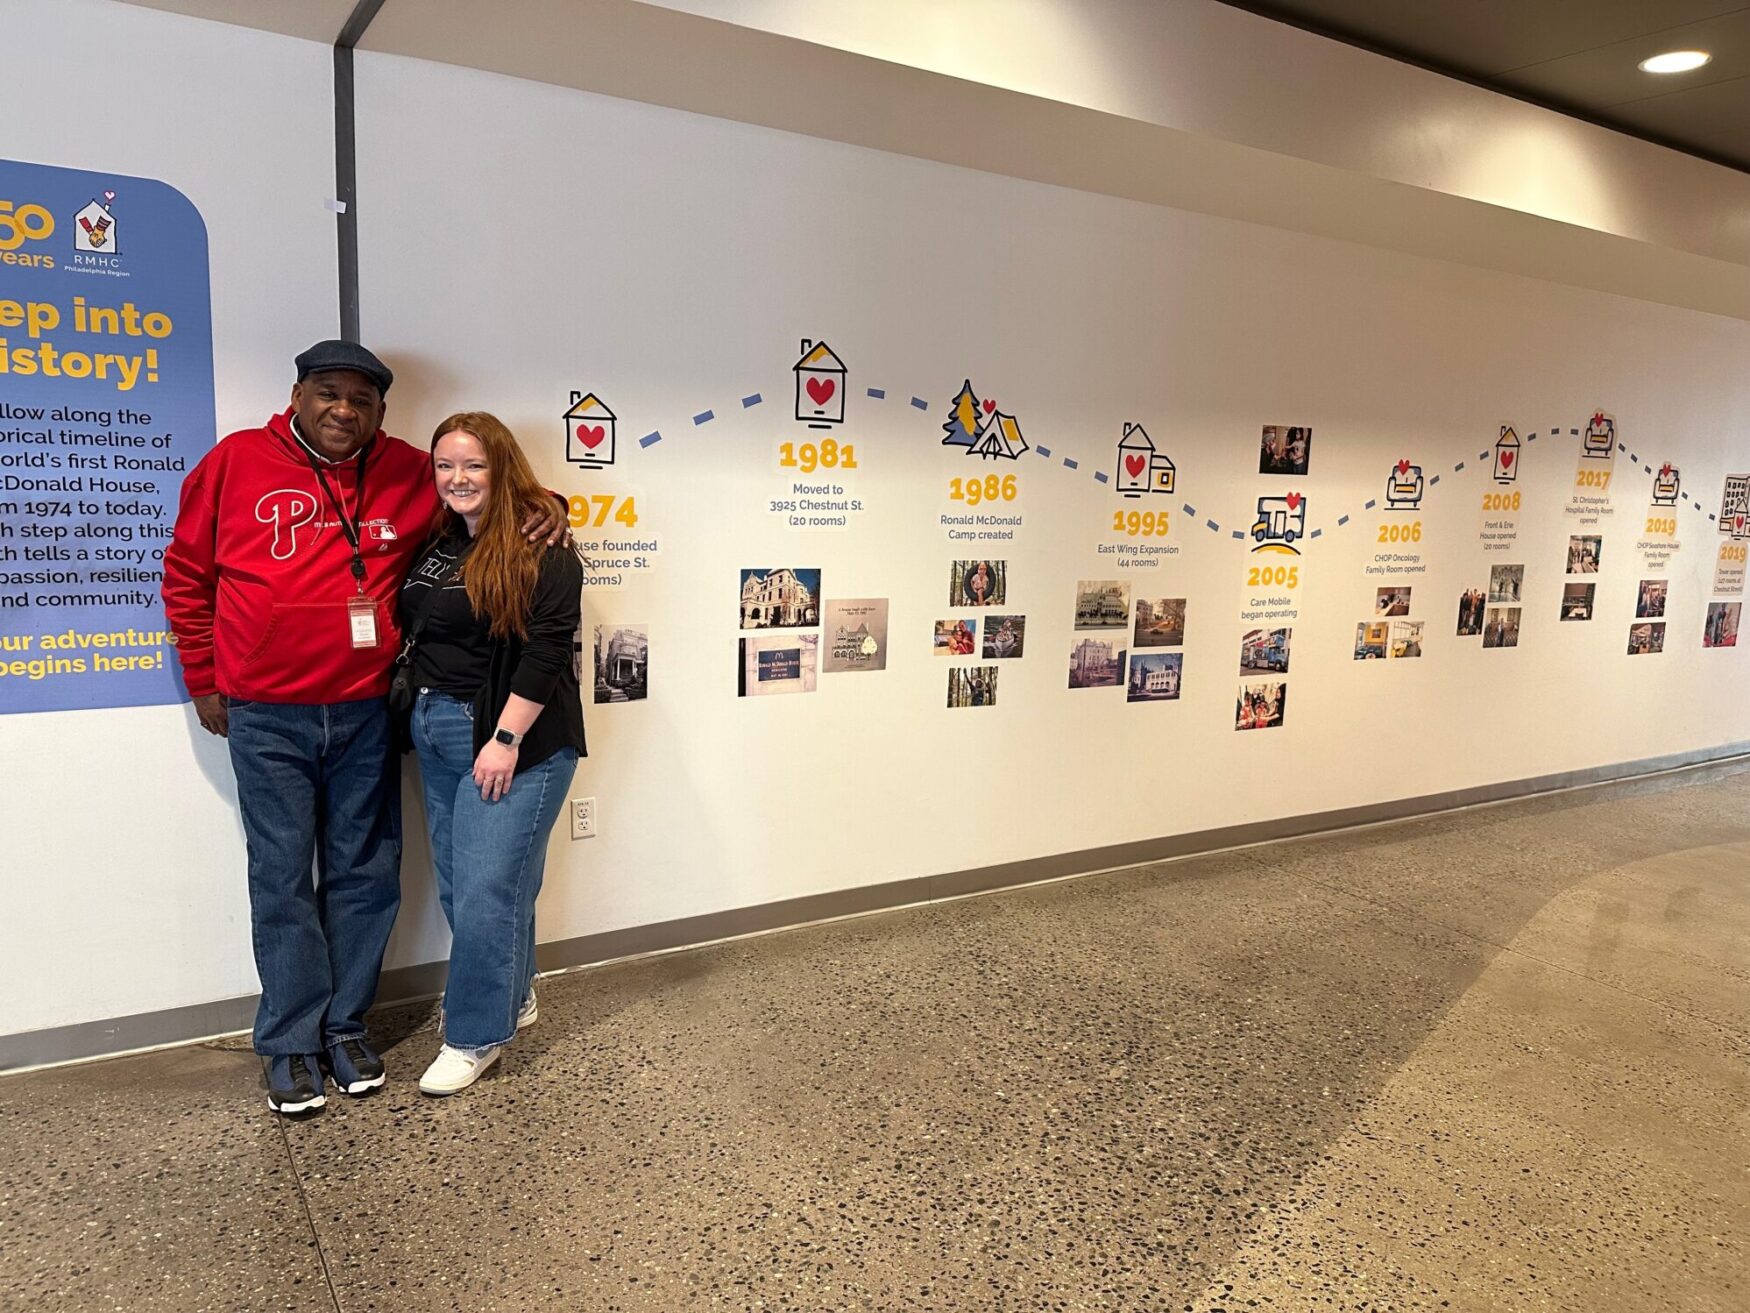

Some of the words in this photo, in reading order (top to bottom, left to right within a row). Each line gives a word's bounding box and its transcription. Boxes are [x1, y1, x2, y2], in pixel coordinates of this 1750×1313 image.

[0, 251, 55, 269] ears
[74, 255, 119, 268] RMHC
[64, 265, 106, 275] Philadelphia
[107, 269, 130, 277] Region
[0, 299, 60, 338] ep
[73, 297, 173, 339] into
[0, 338, 159, 391] istory!
[0, 403, 45, 421] llow
[51, 406, 111, 427] along
[118, 408, 152, 425] the
[0, 429, 54, 444] rical
[59, 430, 146, 448] timeline
[151, 433, 173, 449] of
[1, 452, 62, 469] orld's
[68, 453, 108, 469] first
[114, 455, 185, 472] Ronald
[779, 438, 858, 474] 1981
[0, 475, 83, 492] Donald
[89, 477, 161, 495] House,
[793, 483, 830, 495] Moved
[832, 484, 844, 495] to
[1576, 470, 1611, 490] 2017
[949, 474, 1017, 506] 1986
[26, 502, 72, 517] 1974
[79, 502, 99, 515] to
[106, 500, 167, 519] today.
[770, 501, 797, 512] 3925
[799, 499, 848, 511] Chestnut
[850, 500, 864, 511] St.
[1482, 491, 1521, 511] 2008
[569, 495, 638, 528] 974
[789, 515, 806, 526] (20
[809, 515, 847, 526] rooms)
[940, 514, 974, 525] Ronald
[976, 515, 1022, 526] McDonald
[21, 523, 68, 542] step
[74, 522, 133, 542] along
[139, 522, 174, 539] this
[255, 489, 317, 560] P
[1113, 510, 1169, 537] 1995
[1377, 521, 1422, 543] 2006
[1646, 518, 1676, 536] 2019
[948, 529, 976, 541] Camp
[978, 530, 1013, 540] created
[576, 541, 599, 551] use
[603, 539, 657, 552] founded
[1097, 544, 1115, 553] East
[1117, 544, 1138, 555] Wing
[1139, 544, 1179, 555] Expansion
[1720, 546, 1745, 563] 2019
[24, 546, 70, 561] tells
[76, 549, 89, 561] a
[95, 547, 146, 566] story
[152, 548, 167, 561] o
[584, 557, 630, 571] Spruce
[634, 557, 650, 568] St.
[1117, 557, 1130, 568] (44
[1131, 558, 1158, 567] rooms)
[1374, 554, 1392, 562] CHOP
[1393, 554, 1420, 563] Oncology
[89, 568, 163, 584] resilien
[1247, 566, 1298, 589] 2005
[1366, 565, 1385, 575] Family
[1386, 565, 1403, 573] Room
[1404, 564, 1426, 573] opened
[582, 573, 622, 586] ooms)
[1, 592, 29, 607] nd
[36, 590, 158, 608] community.
[1250, 598, 1267, 607] Care
[1268, 597, 1291, 606] Mobile
[1241, 610, 1263, 621] began
[1265, 609, 1298, 620] operating
[0, 634, 33, 651] ur
[40, 628, 179, 650] adventure
[94, 651, 163, 672] here!
